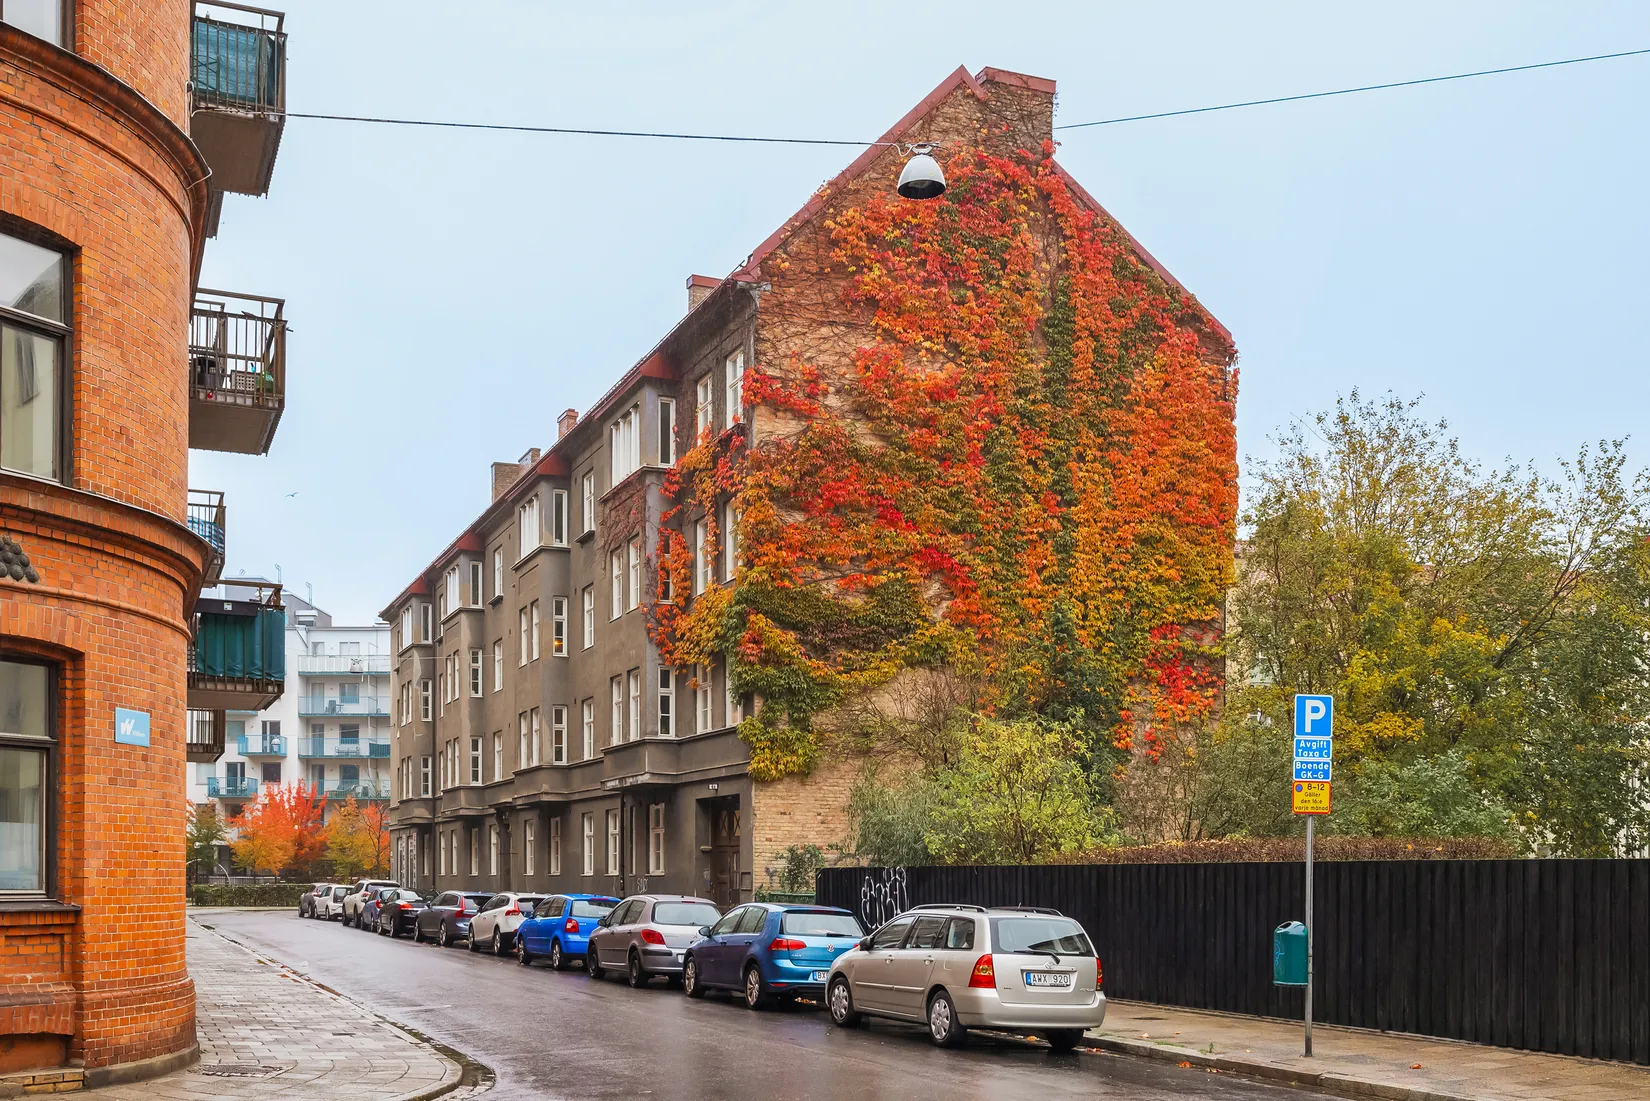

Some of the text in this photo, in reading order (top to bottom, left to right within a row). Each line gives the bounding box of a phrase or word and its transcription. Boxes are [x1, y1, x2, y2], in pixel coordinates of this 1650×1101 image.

[1305, 699, 1326, 733] P
[1300, 740, 1327, 749] Avgift
[1298, 749, 1328, 758] Taxa C
[1296, 762, 1329, 770] Boende
[1301, 771, 1324, 779] GK-G
[1307, 783, 1325, 791] 8-12
[1032, 974, 1068, 984] AWX 920
